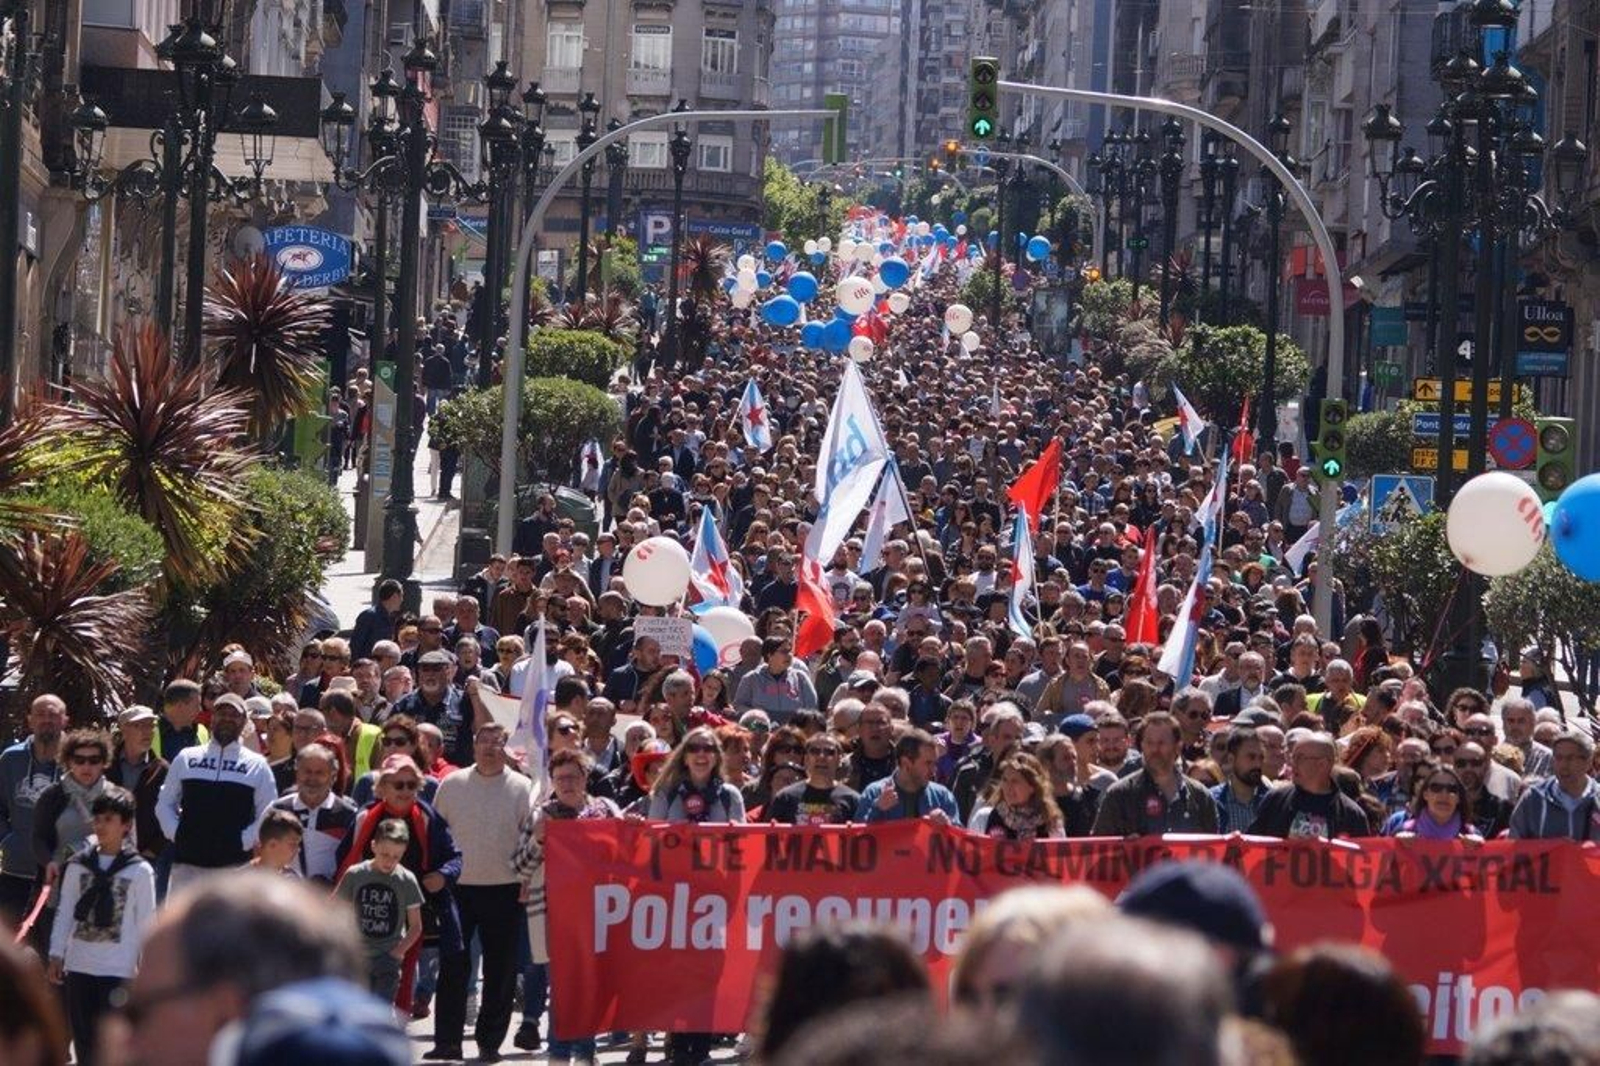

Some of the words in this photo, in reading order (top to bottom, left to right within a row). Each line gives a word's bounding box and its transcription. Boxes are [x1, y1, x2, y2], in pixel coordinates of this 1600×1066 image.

[647, 215, 670, 244] P
[708, 225, 730, 235] Caixa
[731, 227, 753, 237] Geral
[1523, 305, 1564, 321] Ulloa
[691, 833, 748, 872] DE
[765, 833, 878, 873] MAIO
[927, 833, 982, 878] NO
[1264, 842, 1401, 894] FOLGA
[1417, 850, 1561, 894] XERAL
[362, 904, 390, 919] THIS
[593, 883, 728, 953] Pola
[746, 894, 990, 956] recupe
[361, 919, 391, 933] TOWN
